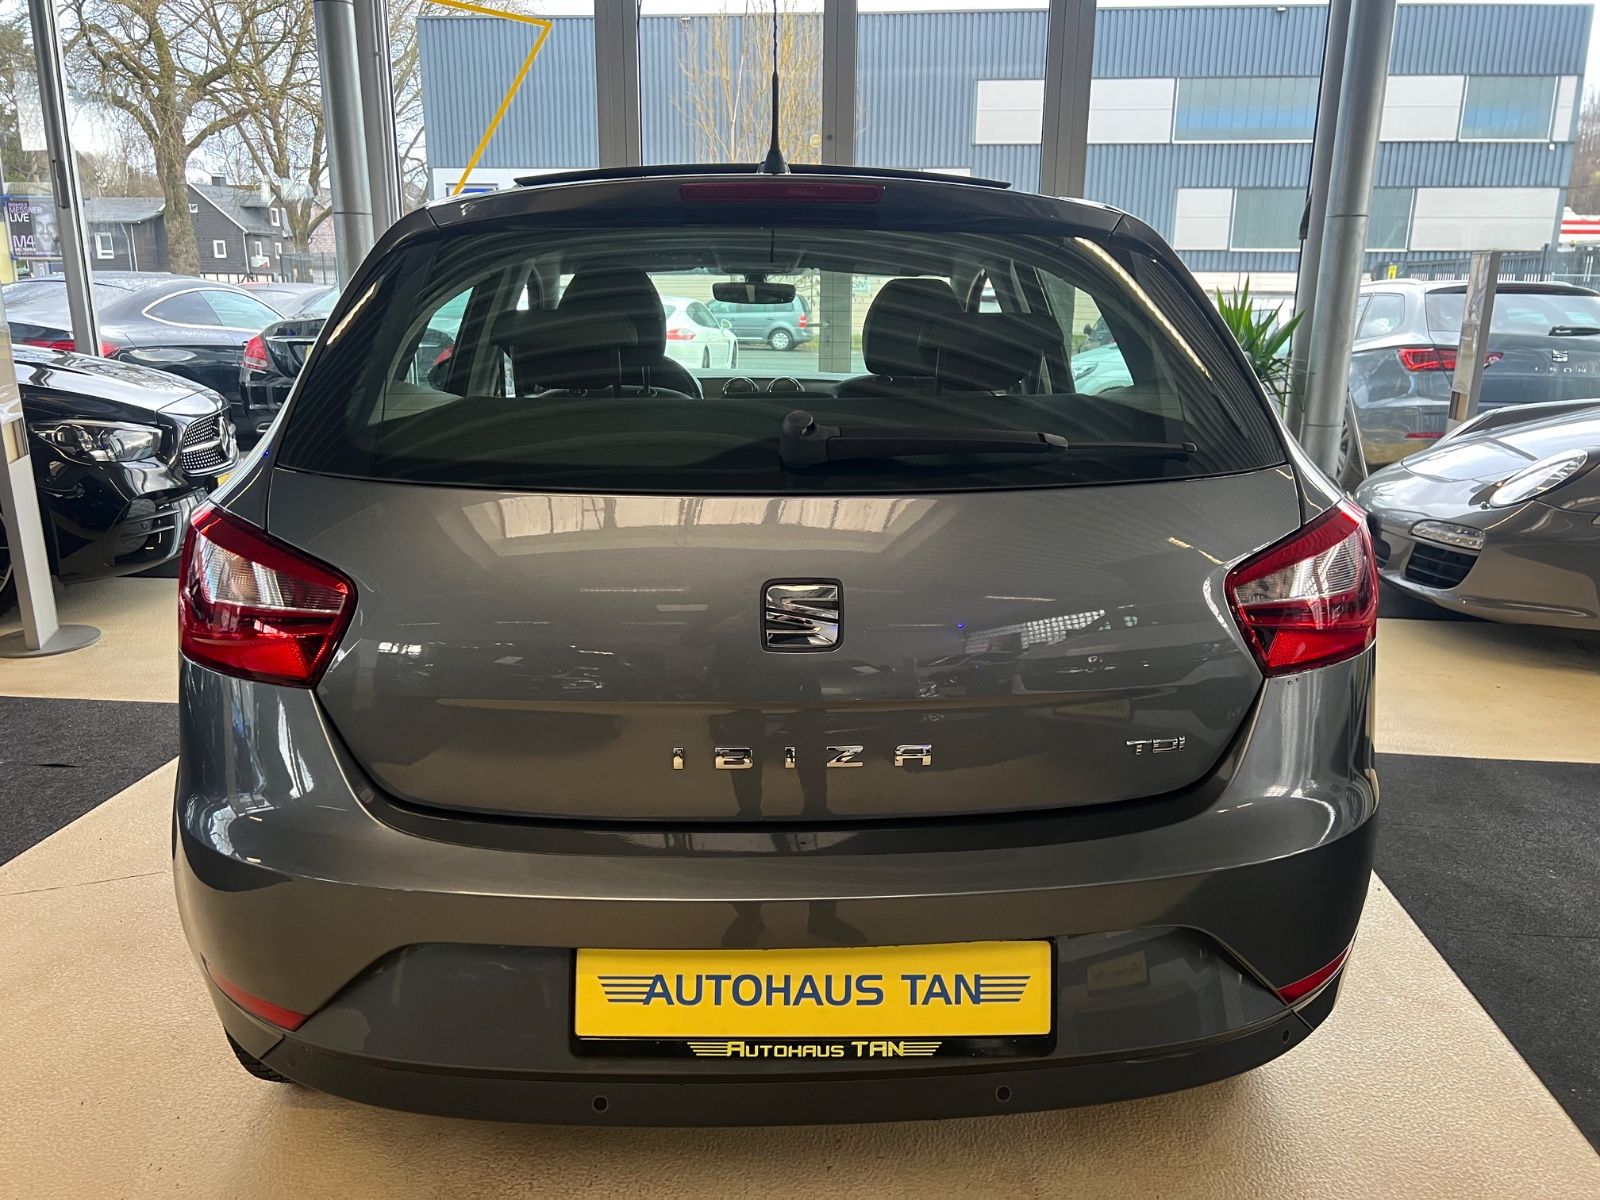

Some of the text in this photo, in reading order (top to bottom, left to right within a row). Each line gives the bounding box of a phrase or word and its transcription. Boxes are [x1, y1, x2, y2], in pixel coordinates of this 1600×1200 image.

[10, 213, 29, 222] LIVE
[13, 235, 35, 247] M4
[672, 744, 932, 770] IBIZA
[643, 974, 981, 1007] AUTOHAUS TAN
[727, 1041, 905, 1058] AUTOHAUS TAN
